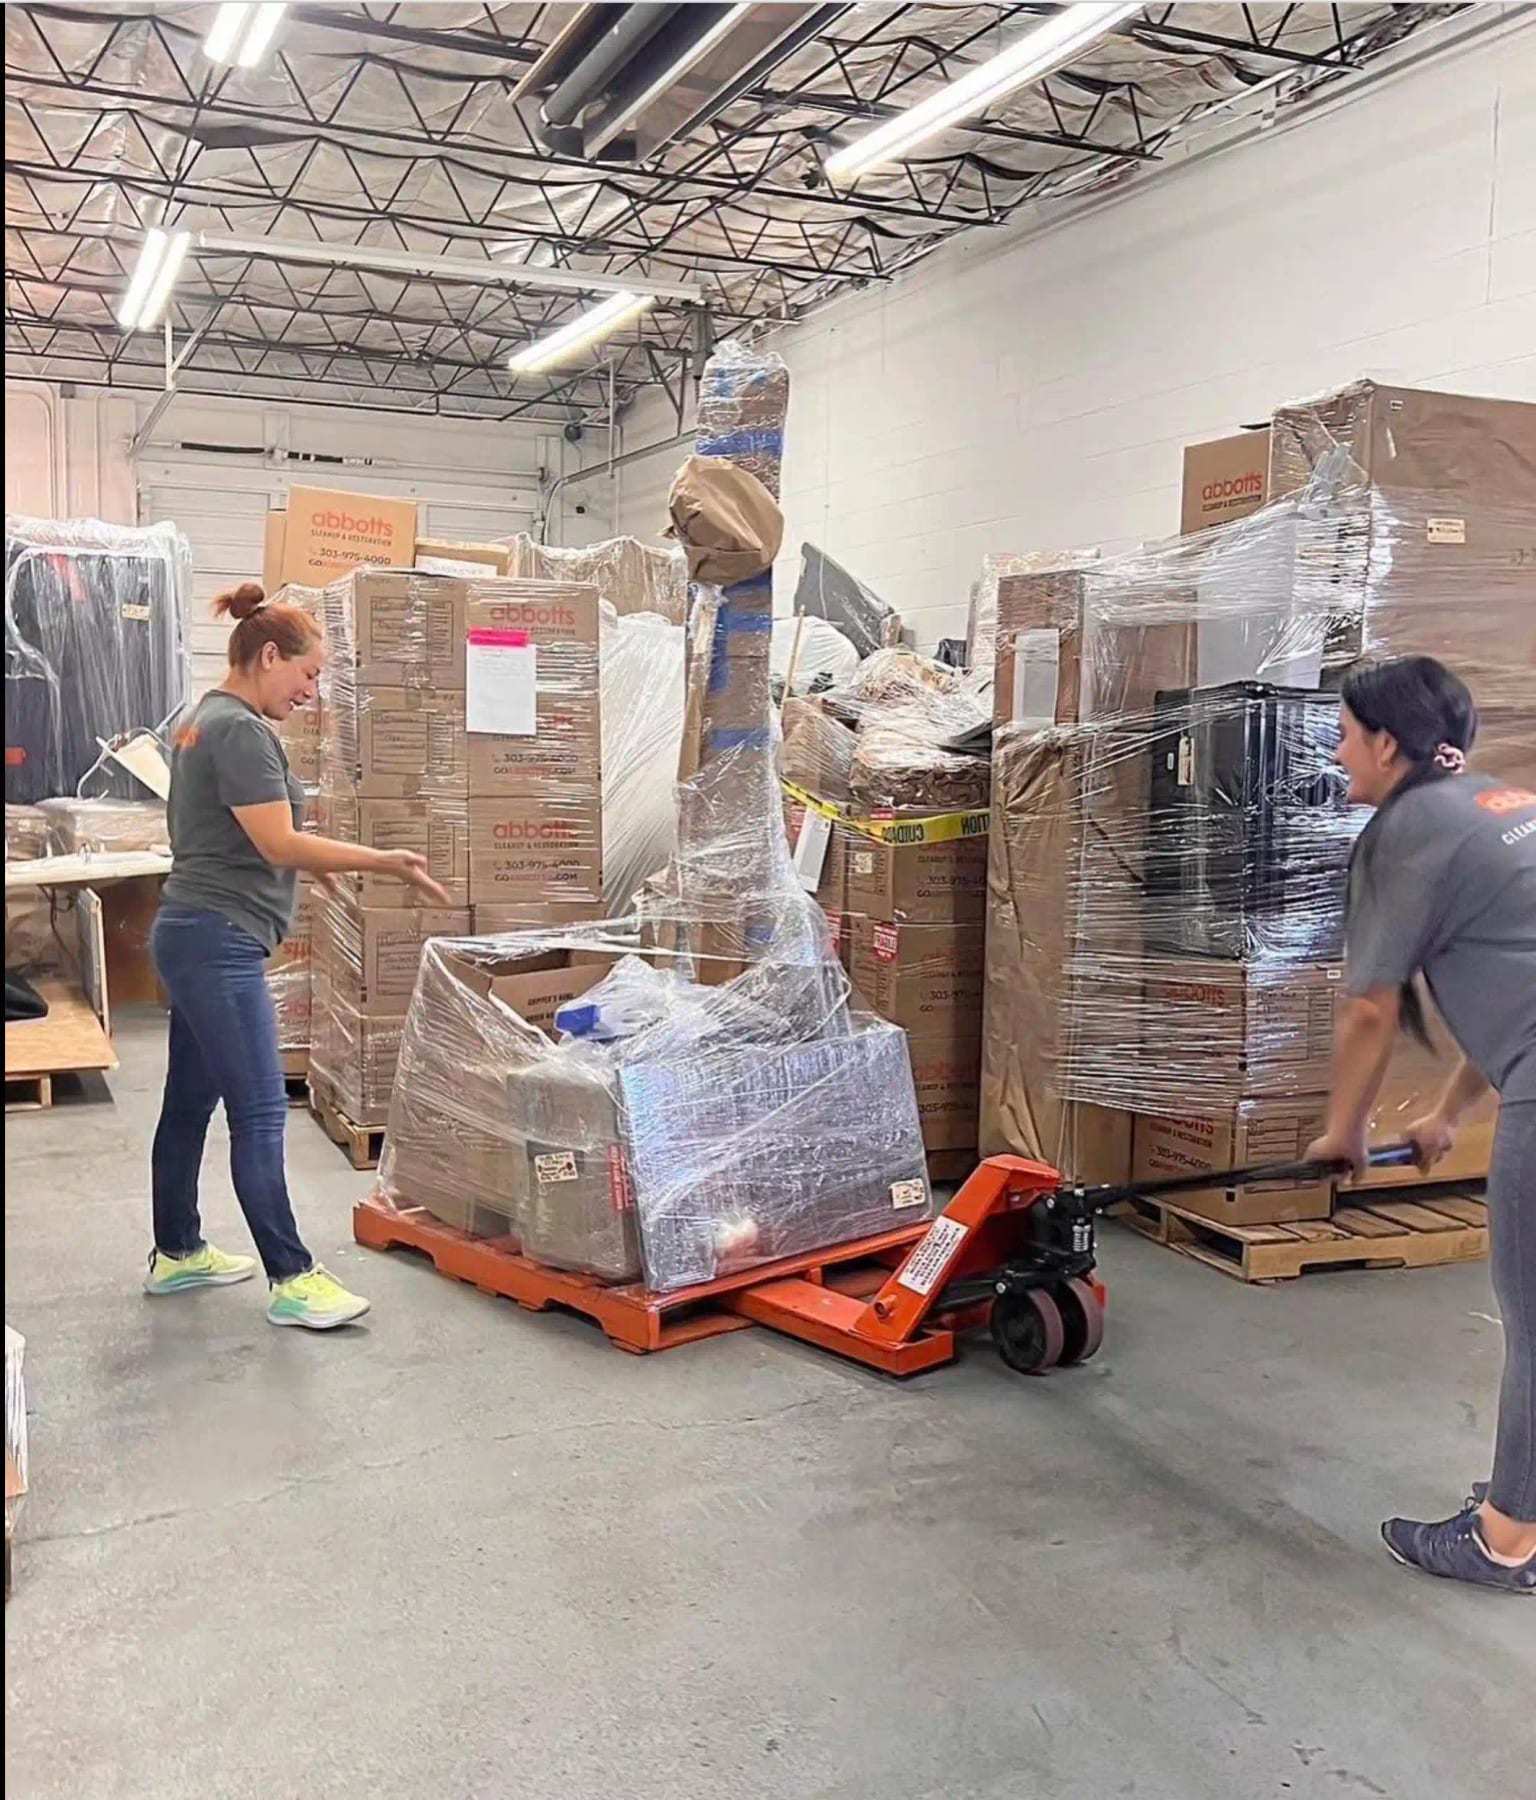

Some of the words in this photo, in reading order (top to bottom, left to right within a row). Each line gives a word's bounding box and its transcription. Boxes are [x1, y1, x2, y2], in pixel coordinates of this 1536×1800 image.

[1202, 472, 1263, 500] abbotts
[311, 511, 393, 536] abbotts
[489, 603, 576, 625] abbotts
